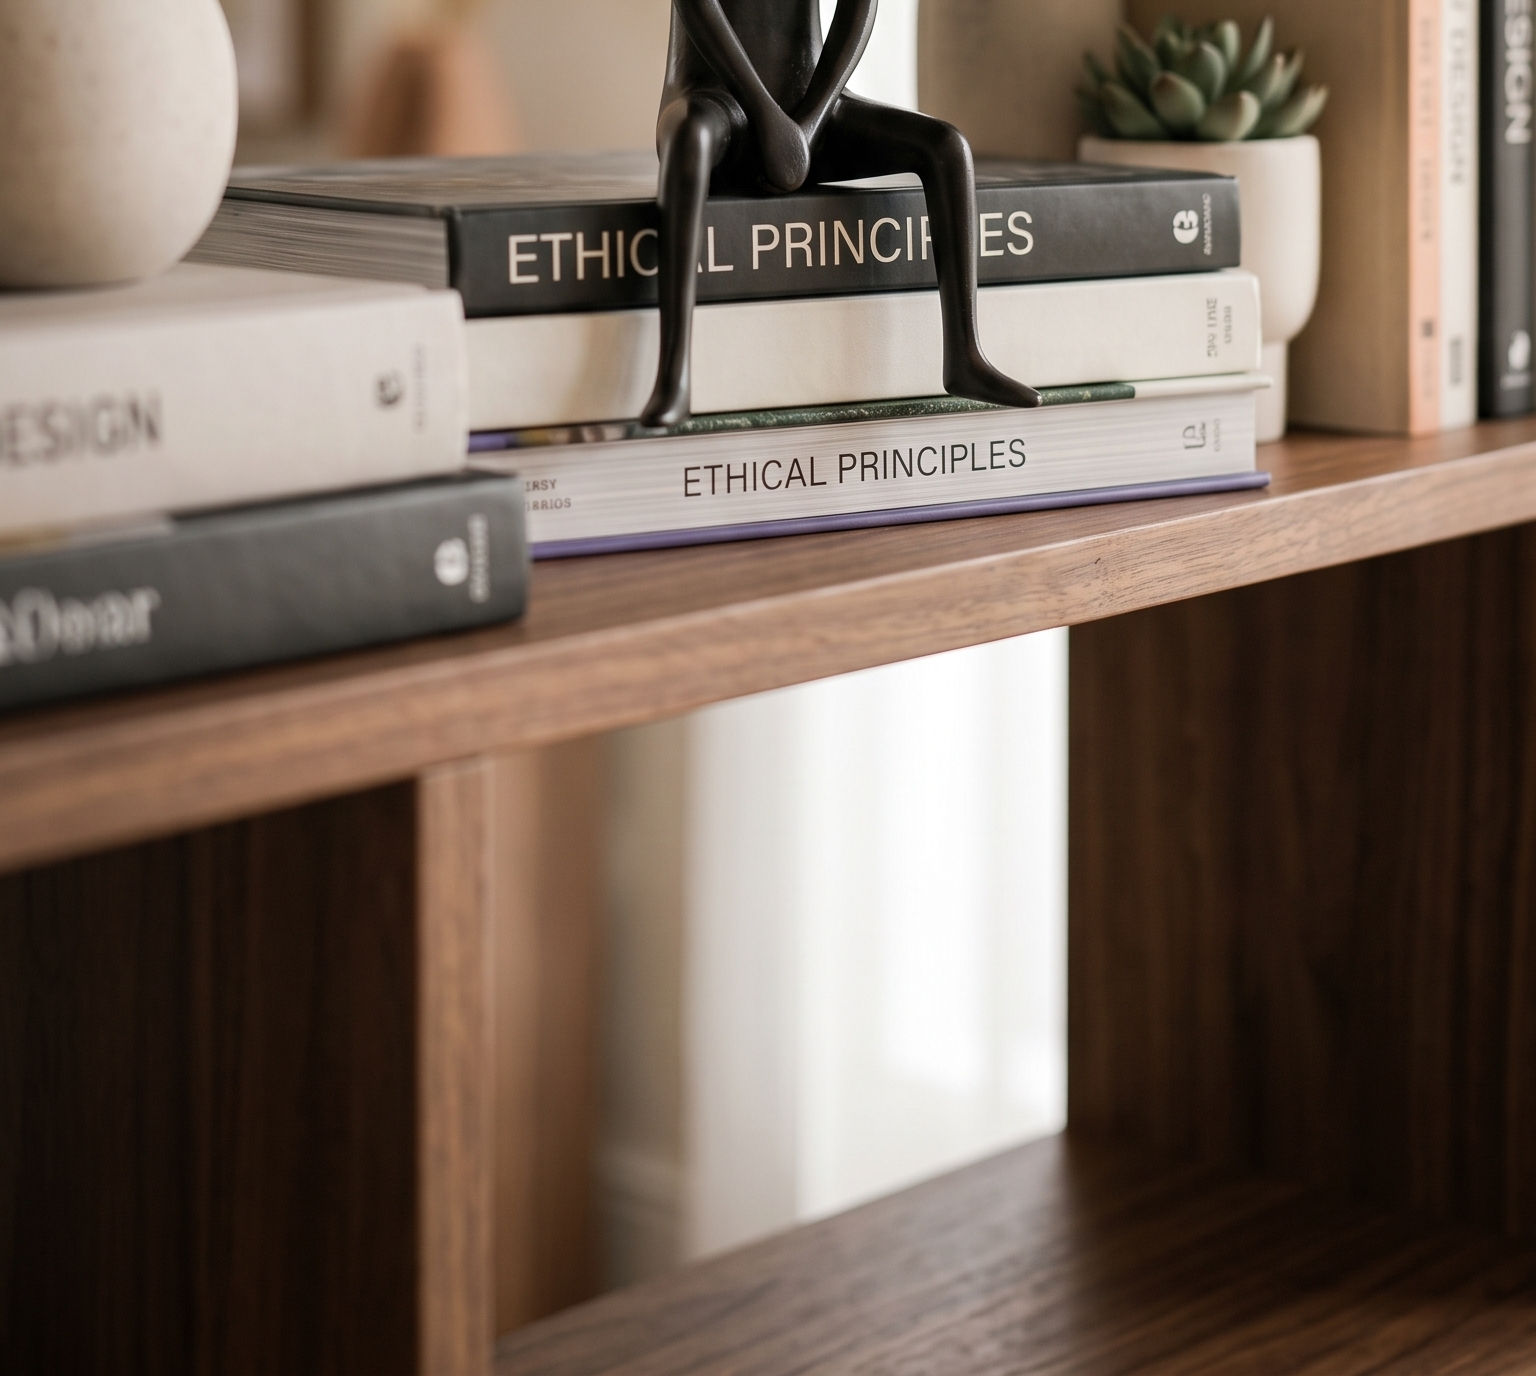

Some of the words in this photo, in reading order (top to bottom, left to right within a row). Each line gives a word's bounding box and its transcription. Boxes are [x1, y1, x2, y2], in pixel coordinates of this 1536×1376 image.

[508, 226, 734, 284] ETHICL
[750, 210, 1034, 270] PRINCIES
[0, 390, 163, 468] ESIGN
[683, 456, 827, 497] ETHICAL
[838, 438, 1026, 484] PRINCIPLES
